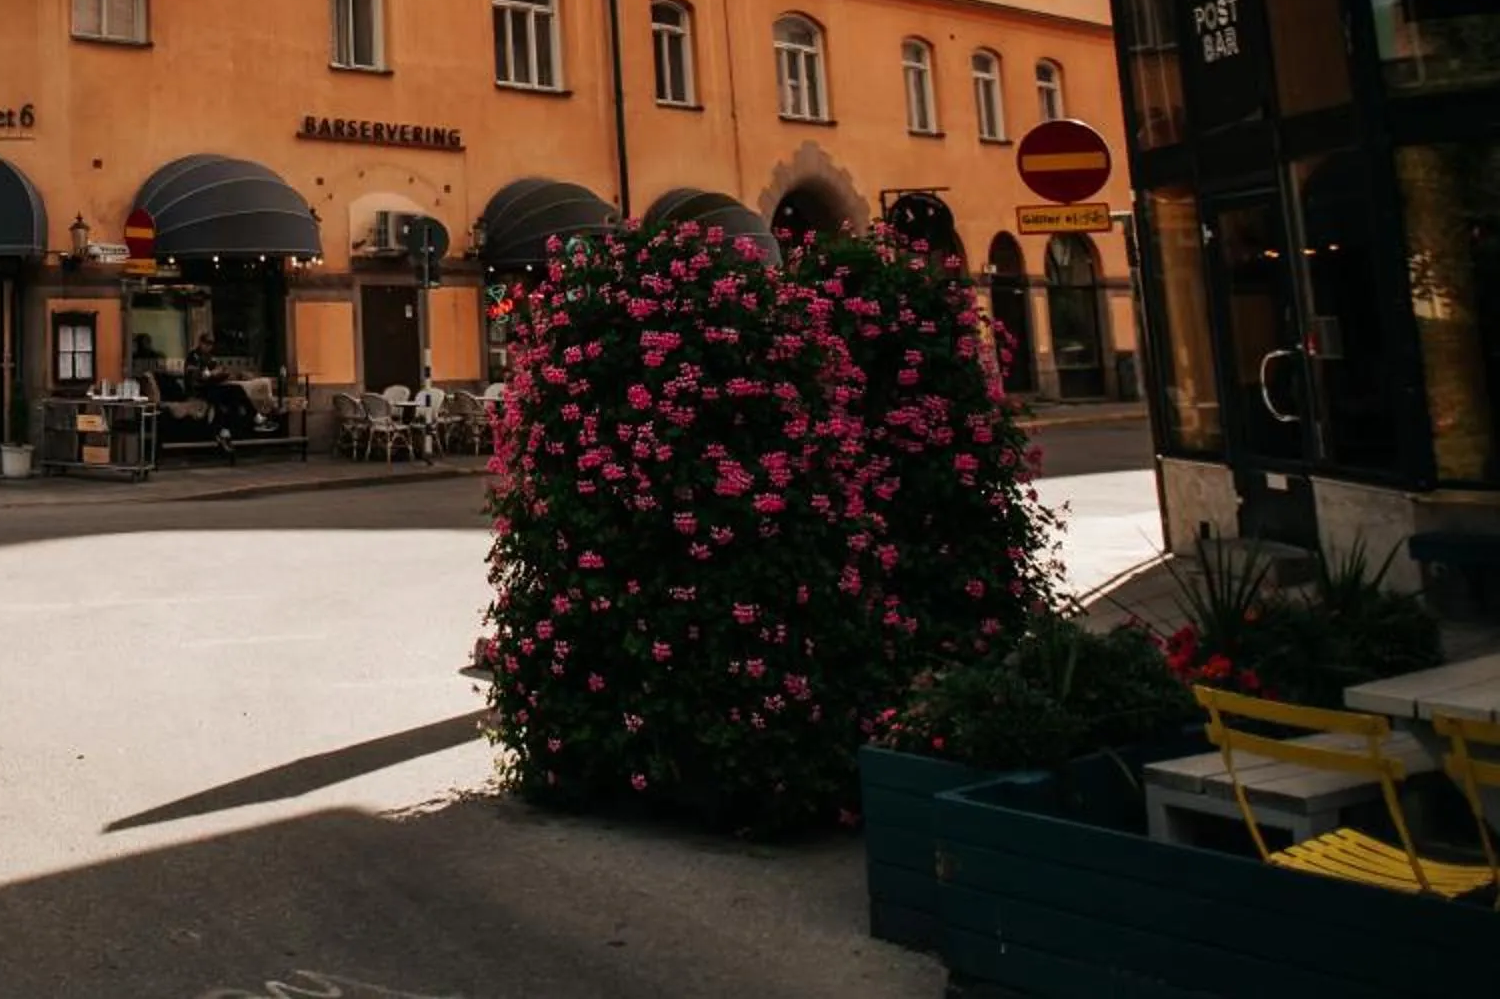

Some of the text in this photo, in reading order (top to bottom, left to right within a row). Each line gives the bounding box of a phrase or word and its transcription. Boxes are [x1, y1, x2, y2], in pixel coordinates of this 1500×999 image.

[1202, 26, 1240, 63] BAR
[19, 104, 35, 128] 6
[303, 115, 461, 147] BARSERVERING
